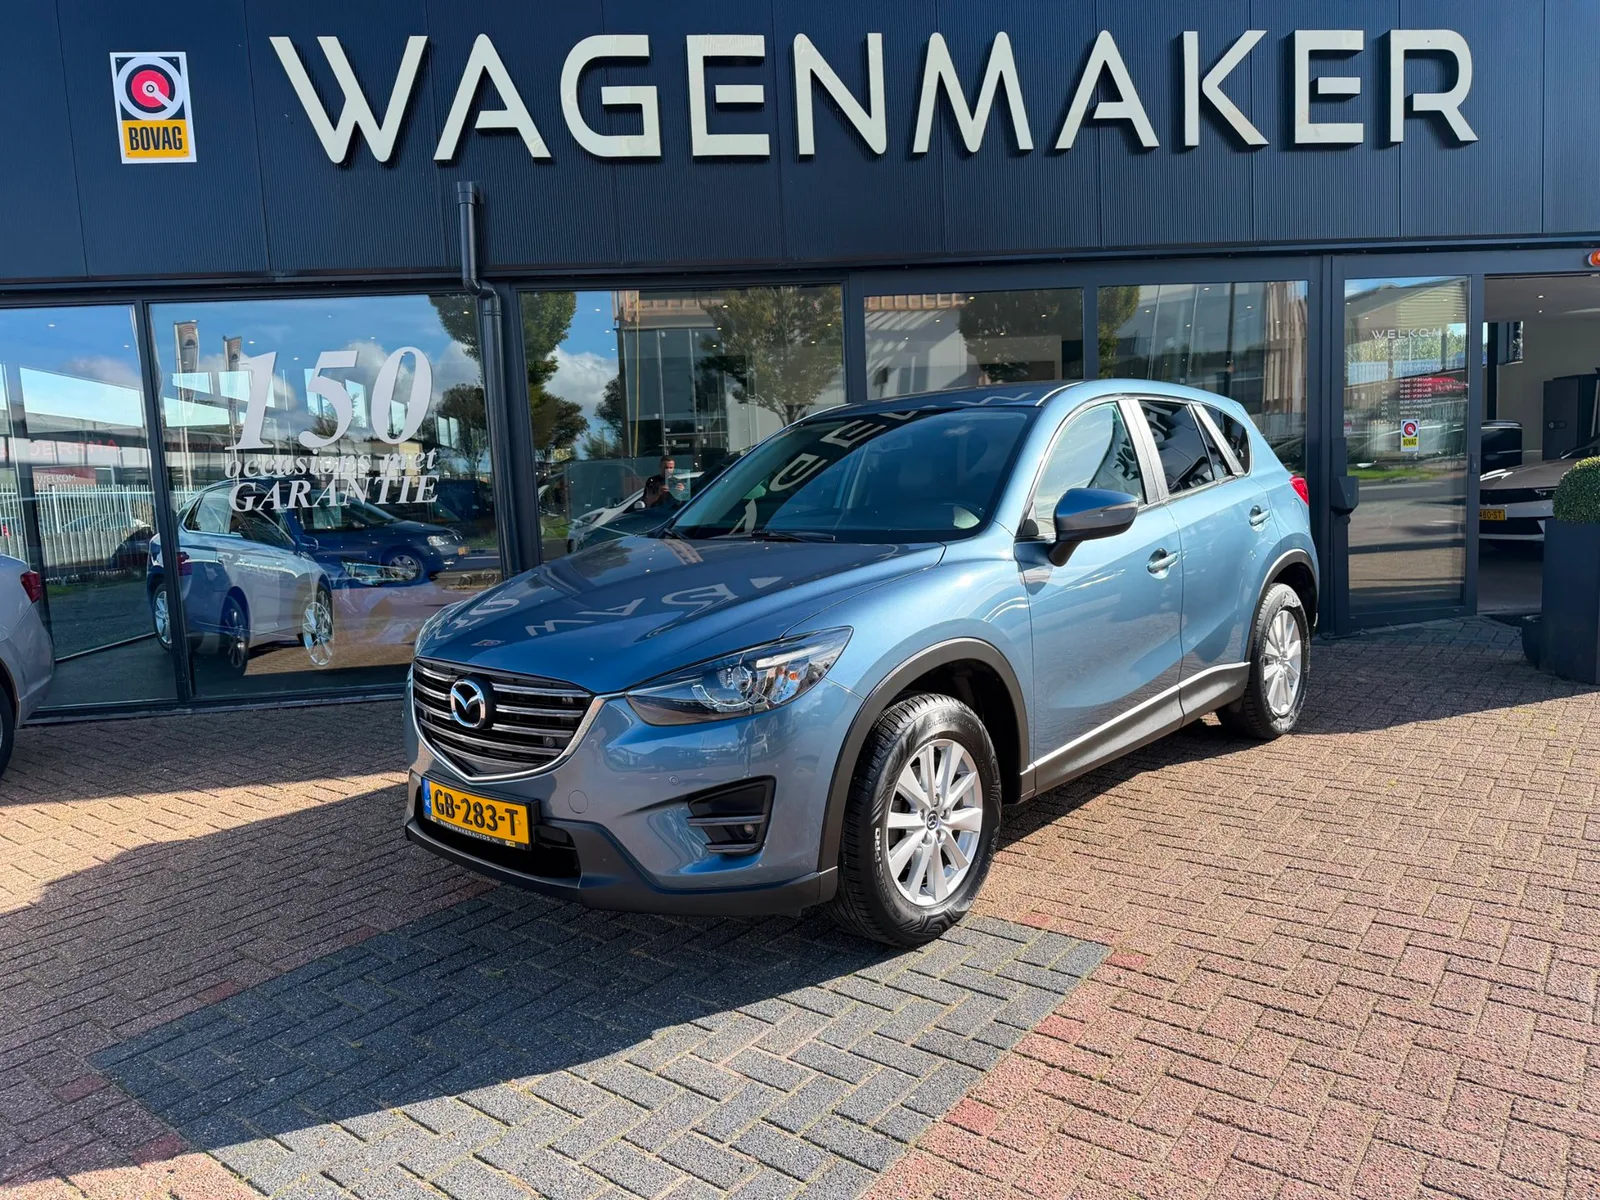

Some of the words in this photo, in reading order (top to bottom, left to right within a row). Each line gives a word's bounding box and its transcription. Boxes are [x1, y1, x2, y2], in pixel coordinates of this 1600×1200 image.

[269, 29, 1479, 163] WAGENMAKER
[128, 126, 183, 151] BOVAG
[225, 346, 433, 451] 150
[36, 473, 77, 484] WELKOM
[224, 448, 372, 479] occasions
[381, 447, 437, 473] met
[228, 474, 440, 513] GARANTIE
[434, 789, 519, 836] GB-283-T
